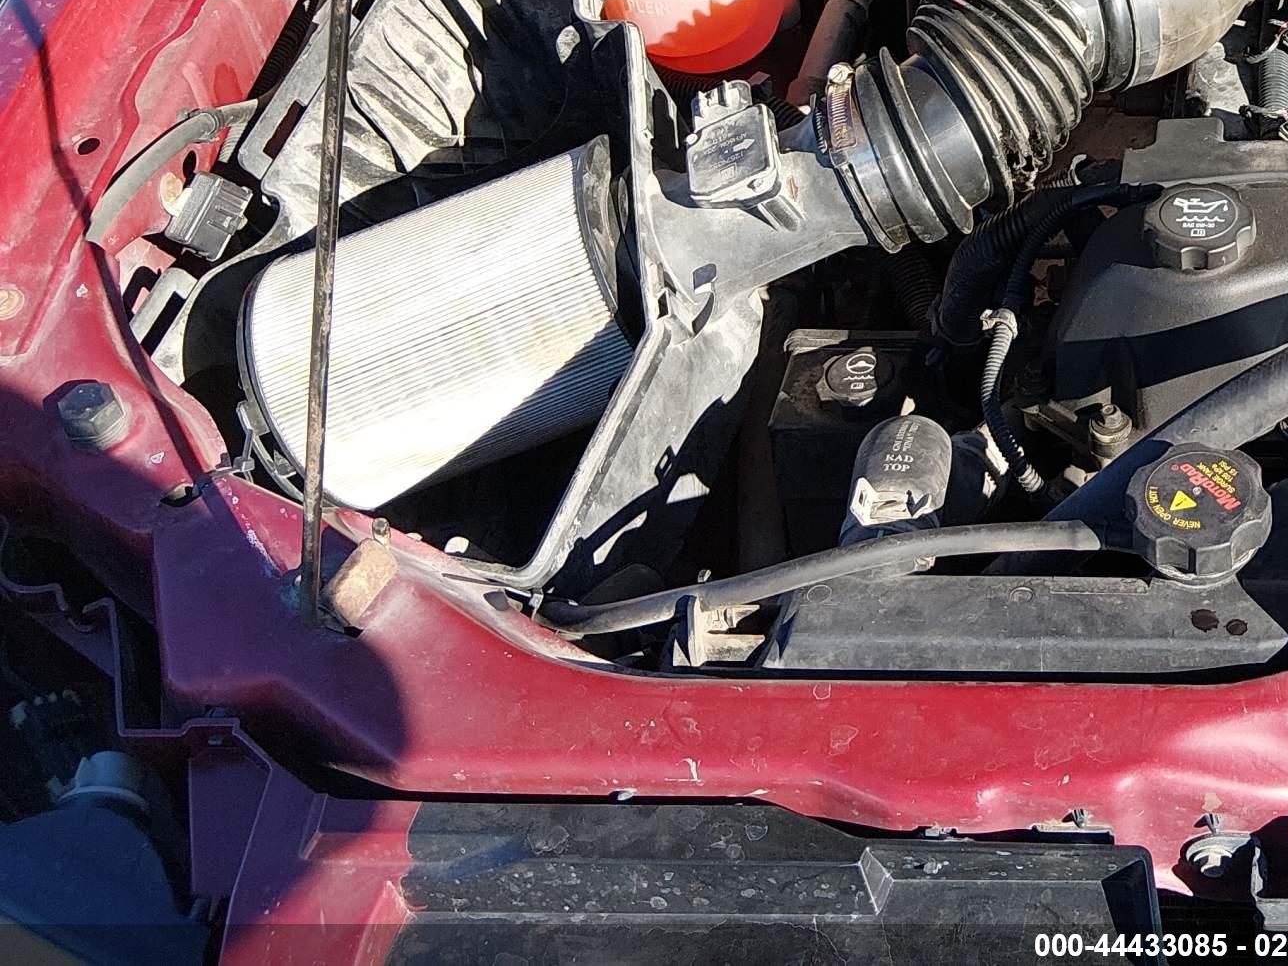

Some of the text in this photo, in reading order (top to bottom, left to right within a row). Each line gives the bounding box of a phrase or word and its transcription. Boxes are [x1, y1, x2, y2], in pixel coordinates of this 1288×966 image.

[885, 454, 914, 463] RAD
[883, 463, 910, 472] TOP
[1152, 504, 1172, 521] OPEN
[1173, 518, 1200, 529] NEVER
